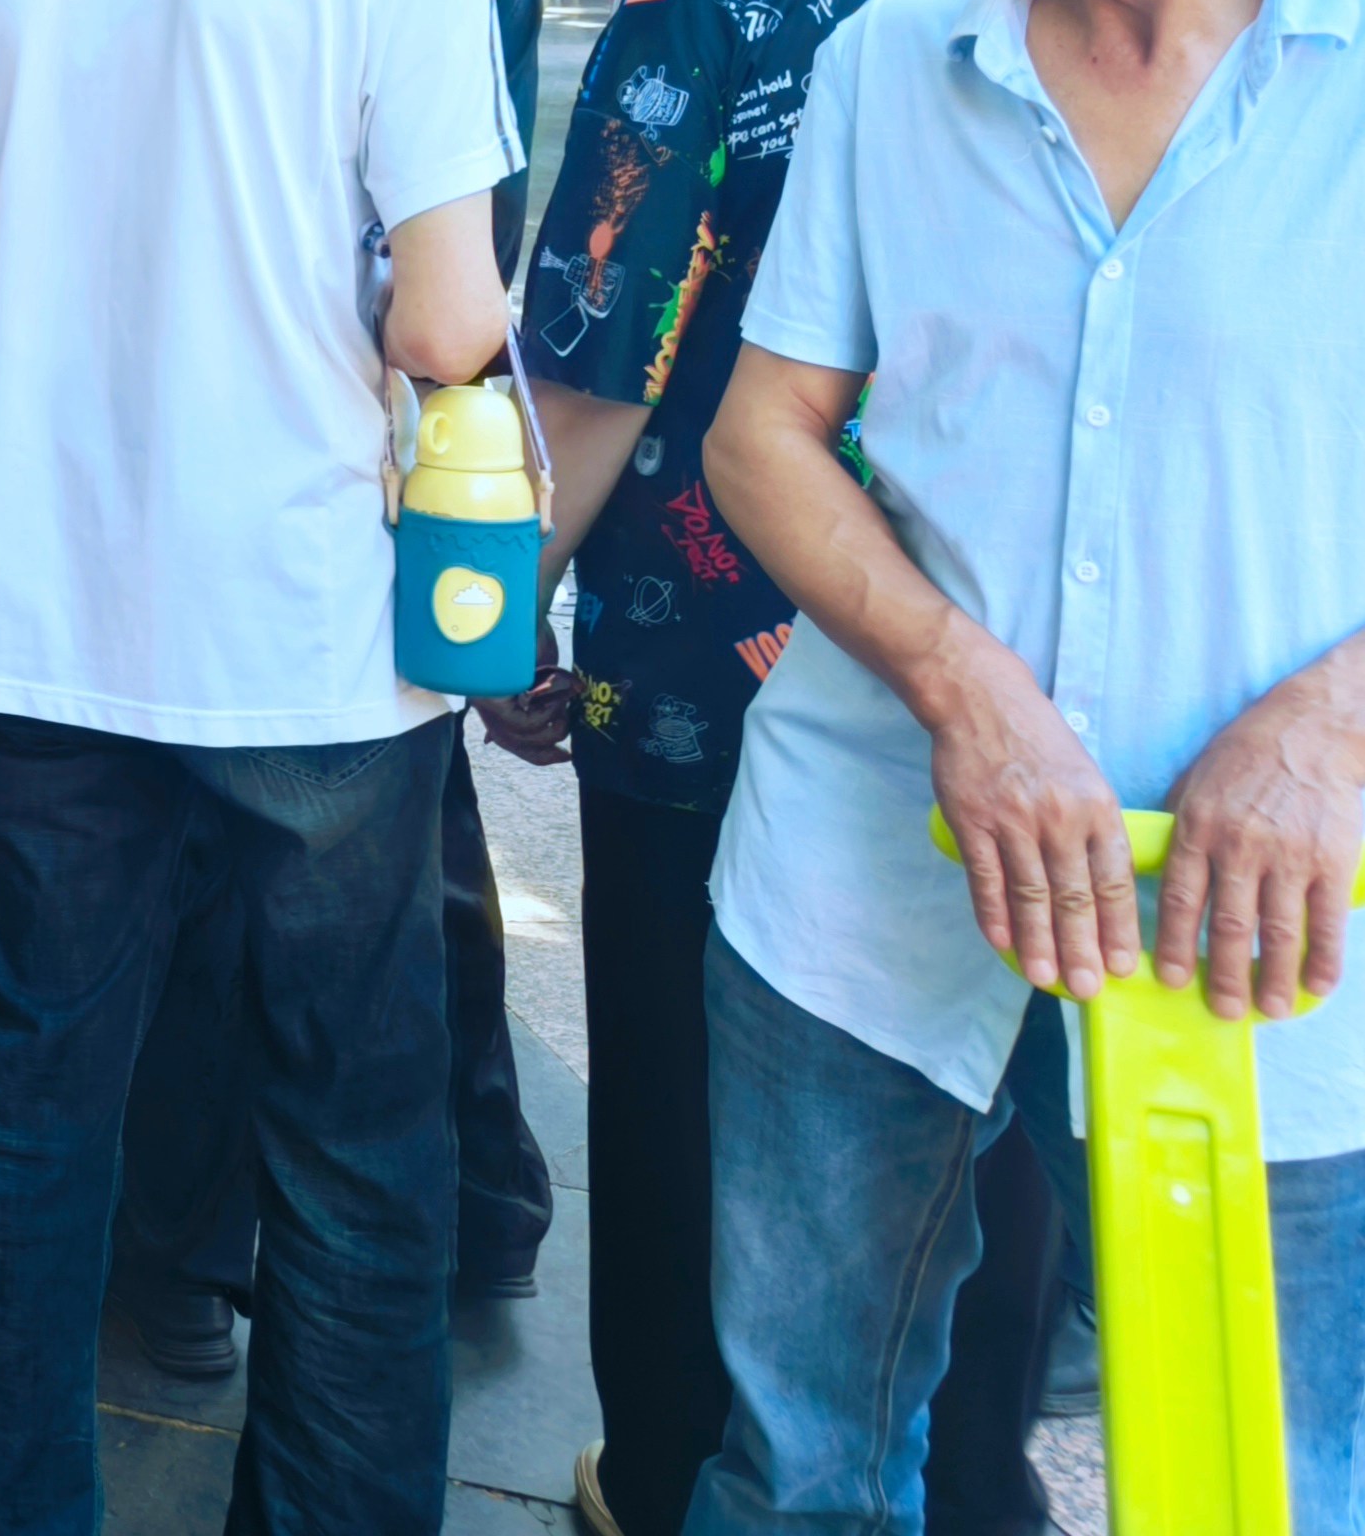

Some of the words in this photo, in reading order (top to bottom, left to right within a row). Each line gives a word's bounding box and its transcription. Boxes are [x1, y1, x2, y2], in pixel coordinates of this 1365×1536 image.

[756, 69, 794, 97] hold
[750, 120, 777, 139] can
[759, 134, 788, 160] you
